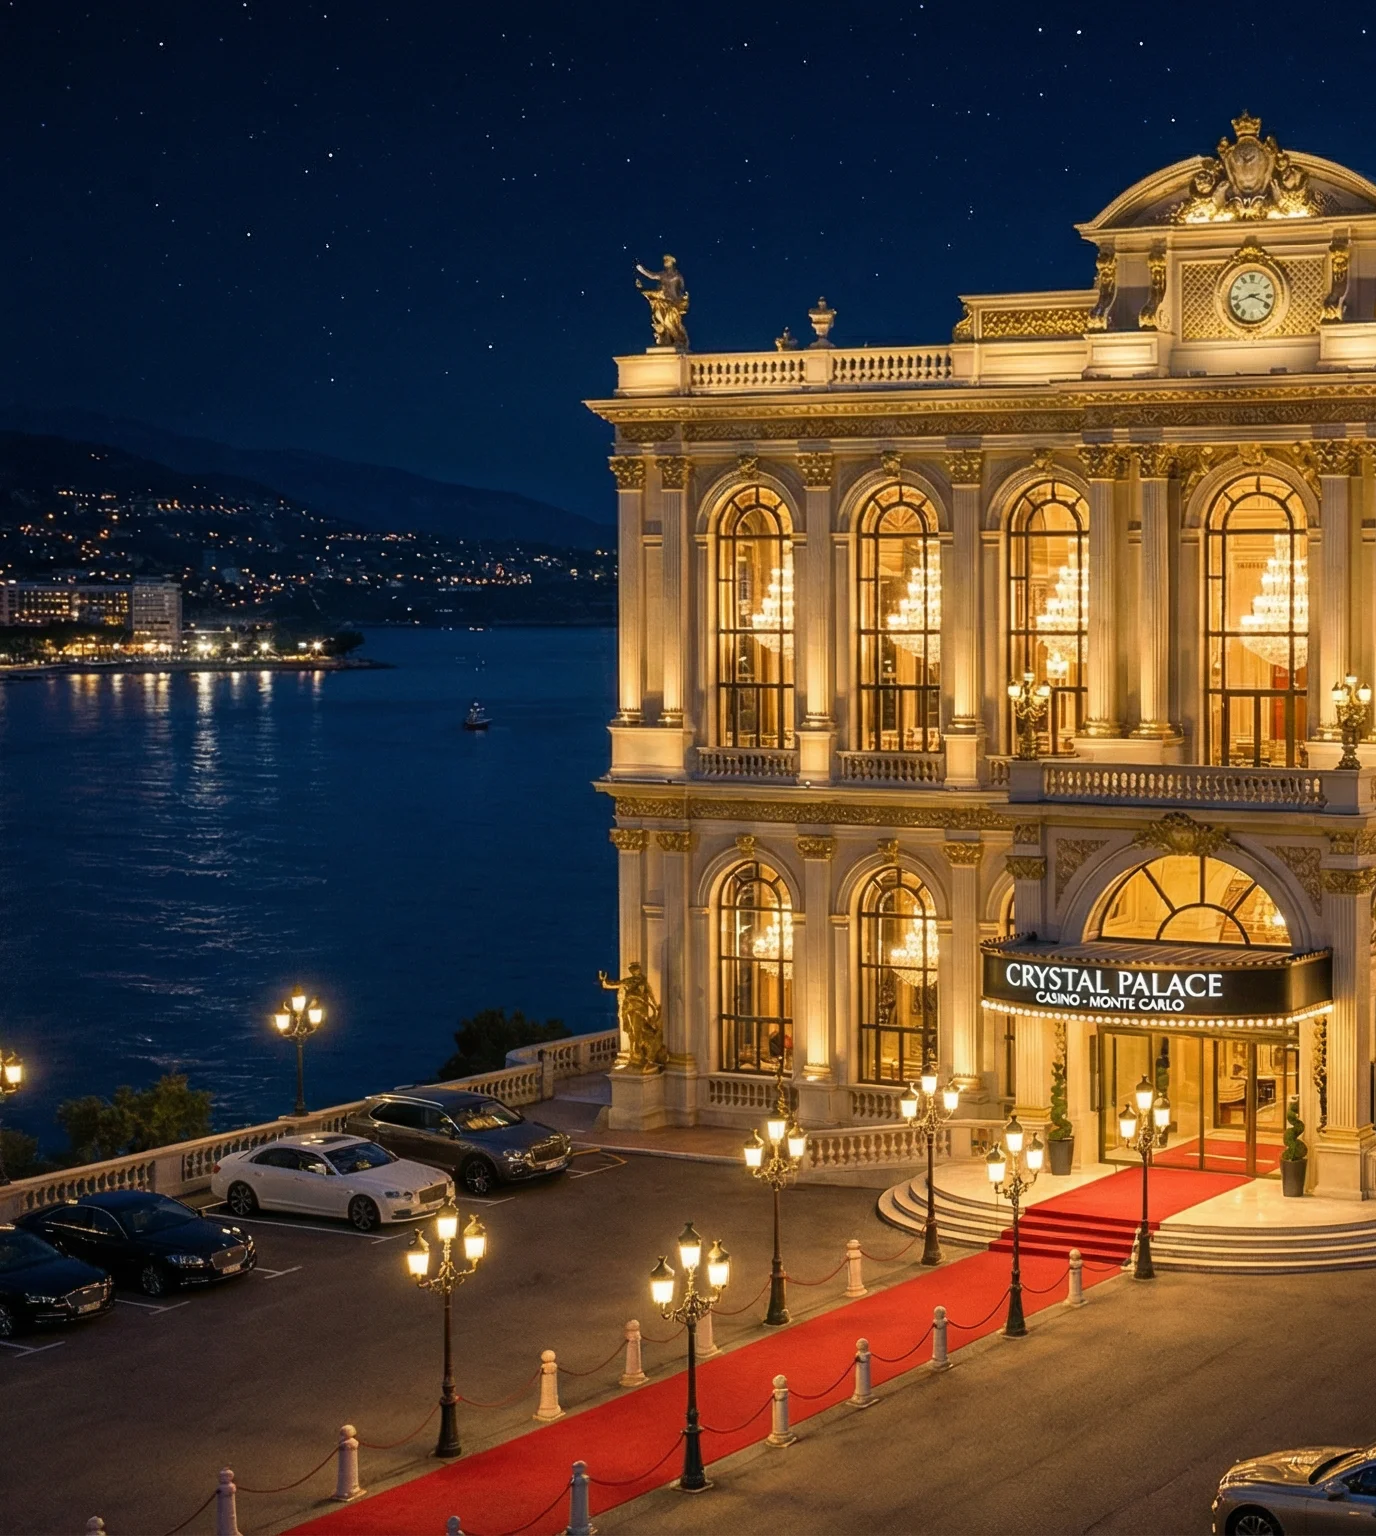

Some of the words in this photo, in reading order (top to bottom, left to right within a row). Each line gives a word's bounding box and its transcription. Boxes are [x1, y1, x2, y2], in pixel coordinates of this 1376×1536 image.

[1006, 963, 1110, 994] CRYSTAL
[1118, 971, 1223, 998] PALACE
[1035, 991, 1080, 1006] CASINO
[1089, 995, 1136, 1009] MONTE
[1138, 998, 1185, 1012] CARLO
